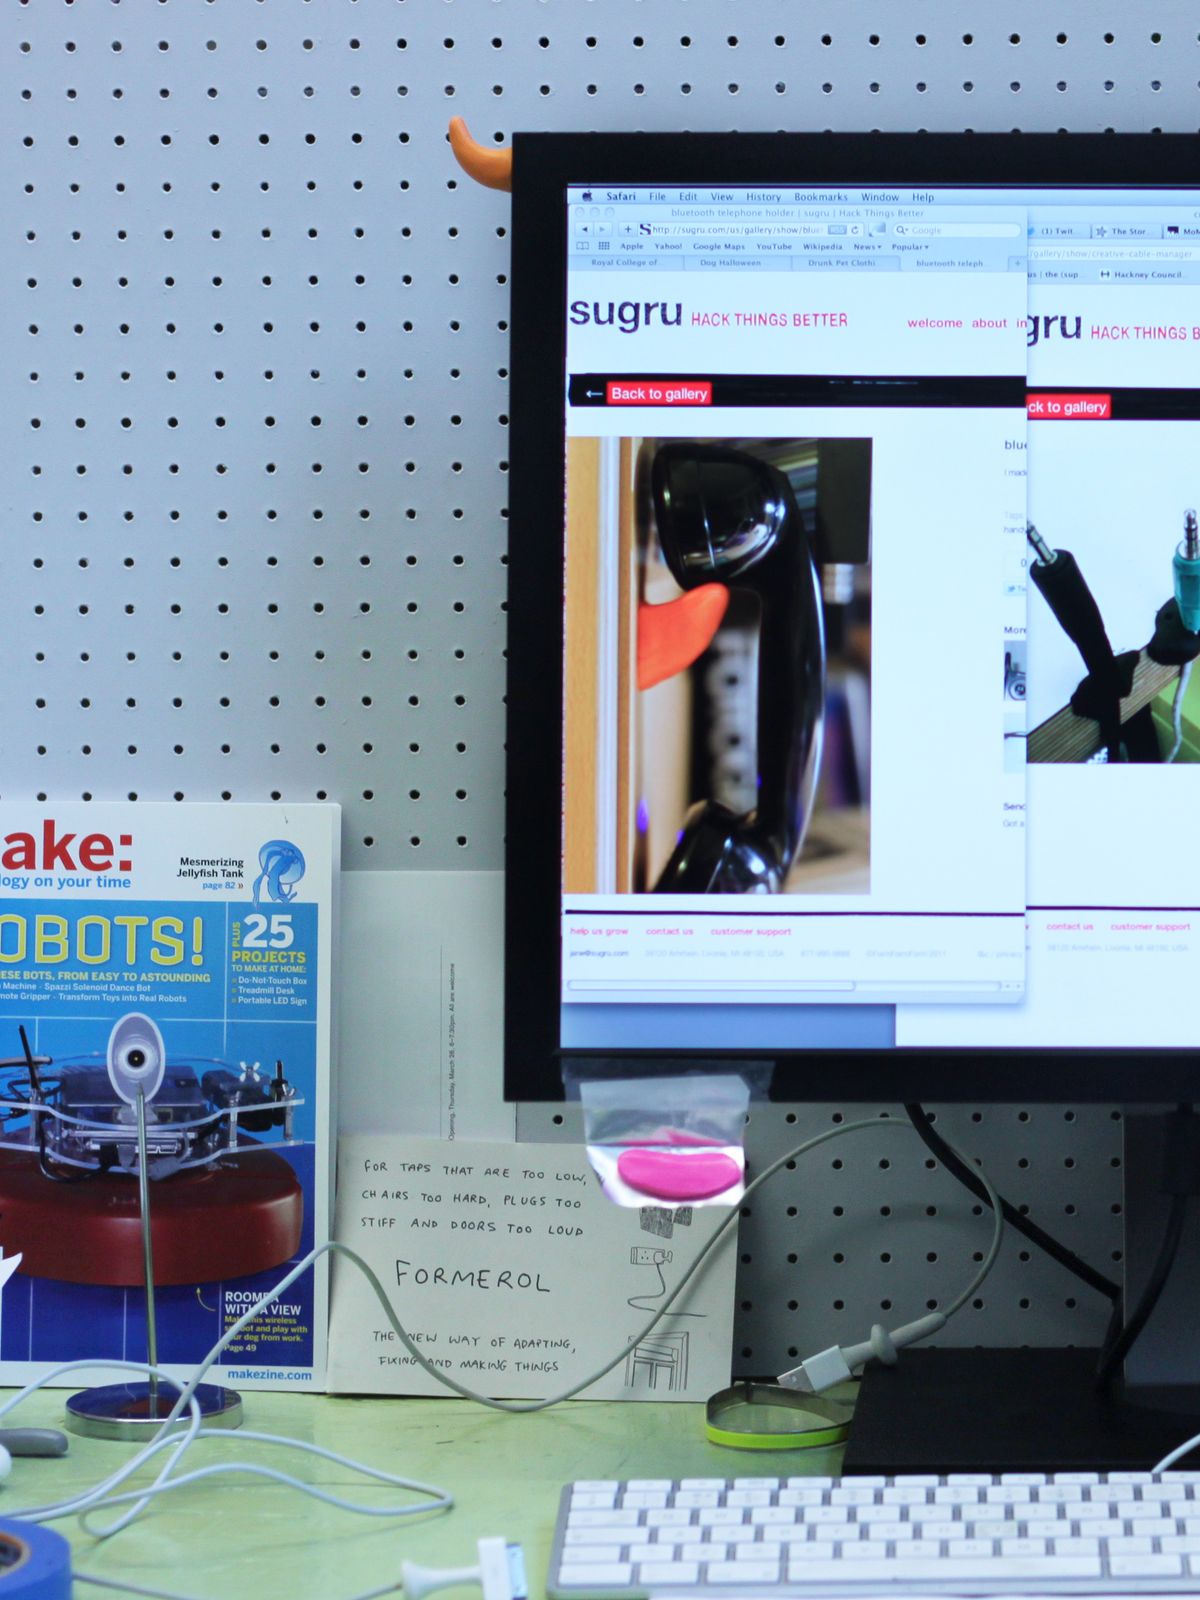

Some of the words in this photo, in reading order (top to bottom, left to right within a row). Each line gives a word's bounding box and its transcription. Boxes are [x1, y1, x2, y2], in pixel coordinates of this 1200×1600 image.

[606, 192, 636, 201] Safari
[649, 192, 666, 201] File
[679, 192, 698, 201] Edit
[711, 192, 734, 201] View
[746, 192, 782, 203] History
[794, 193, 848, 201] Bookmarks
[861, 193, 899, 201] Window
[912, 193, 935, 204] Help
[671, 208, 715, 217] bluetooth
[718, 208, 762, 218] telephone
[765, 208, 794, 217] holder
[804, 210, 830, 220] sugru
[839, 208, 861, 217] Hack
[864, 209, 895, 219] Things
[898, 208, 924, 217] Better
[1114, 271, 1149, 280] Hackney
[1151, 271, 1182, 280] Council
[569, 300, 682, 334] sugru
[691, 312, 730, 326] HACK
[735, 312, 788, 327] THINGS
[792, 313, 848, 327] BETTER
[907, 317, 963, 328] welcome
[972, 317, 1008, 328] about
[1090, 326, 1130, 340] HACK
[1134, 326, 1188, 340] THINGS
[612, 388, 646, 400] Back
[648, 388, 662, 400] to
[665, 388, 708, 402] gallery
[1047, 402, 1061, 414] to
[1064, 402, 1107, 416] gallery
[1, 819, 133, 872] ake:
[180, 857, 244, 868] Mesmerizing
[176, 868, 218, 880] Jellyfish
[220, 868, 244, 878] Tank
[34, 876, 53, 887] on
[57, 877, 92, 890] your
[96, 876, 132, 888] time
[202, 882, 222, 890] page
[232, 922, 241, 948] PLUS
[243, 913, 294, 949] 25
[232, 950, 306, 964] PROJECTS
[23, 972, 56, 981] BOTS,
[58, 972, 88, 980] FROM
[92, 972, 119, 981] EASY
[123, 972, 138, 981] TO
[140, 973, 211, 982] ASTOUNDING
[292, 977, 307, 985] Box
[2, 982, 36, 990] Machine
[44, 983, 71, 992] Spazzi
[73, 983, 108, 991] Solenoid
[110, 984, 135, 992] Dance
[136, 984, 151, 992] Bot
[238, 986, 274, 994] Treadmill
[20, 993, 50, 1002] Gripper
[59, 993, 100, 1001] Transform
[102, 994, 120, 1002] Toys
[122, 994, 138, 1002] into
[139, 994, 156, 1002] Real
[158, 995, 187, 1003] Robots
[238, 996, 272, 1004] Portable
[290, 997, 308, 1006] Sign
[364, 1160, 388, 1172] FOR
[400, 1163, 432, 1173] TAPS
[443, 1166, 474, 1176] THAT
[484, 1168, 510, 1178] ARE
[522, 1170, 544, 1180] TOO
[555, 1173, 587, 1186] LOW,
[361, 1190, 409, 1200] CHAIRS
[420, 1193, 442, 1203] TOO
[453, 1194, 491, 1208] HARD,
[504, 1195, 547, 1206] PLUGS
[556, 1198, 582, 1209] TOO
[361, 1217, 396, 1228] STIFF
[410, 1218, 438, 1228] AND
[451, 1220, 497, 1232] DOORS
[507, 1224, 532, 1234] TOO
[548, 1226, 584, 1236] LOUD
[396, 1259, 551, 1293] FORMEROL
[271, 1304, 302, 1316] VIEW
[272, 1326, 288, 1334] play
[244, 1334, 258, 1342] dog
[261, 1334, 280, 1342] from
[373, 1330, 395, 1342] THE
[406, 1332, 438, 1342] NEW
[449, 1335, 480, 1346] WAY
[490, 1336, 506, 1348] OF
[513, 1338, 576, 1354] ADAPTING,
[224, 1344, 244, 1352] Page
[246, 1344, 256, 1352] 49
[378, 1356, 418, 1366] FIXING
[427, 1358, 452, 1368] AND
[460, 1359, 508, 1372] MAKING
[515, 1361, 560, 1372] THINGS
[228, 1369, 312, 1380] makezine.com
